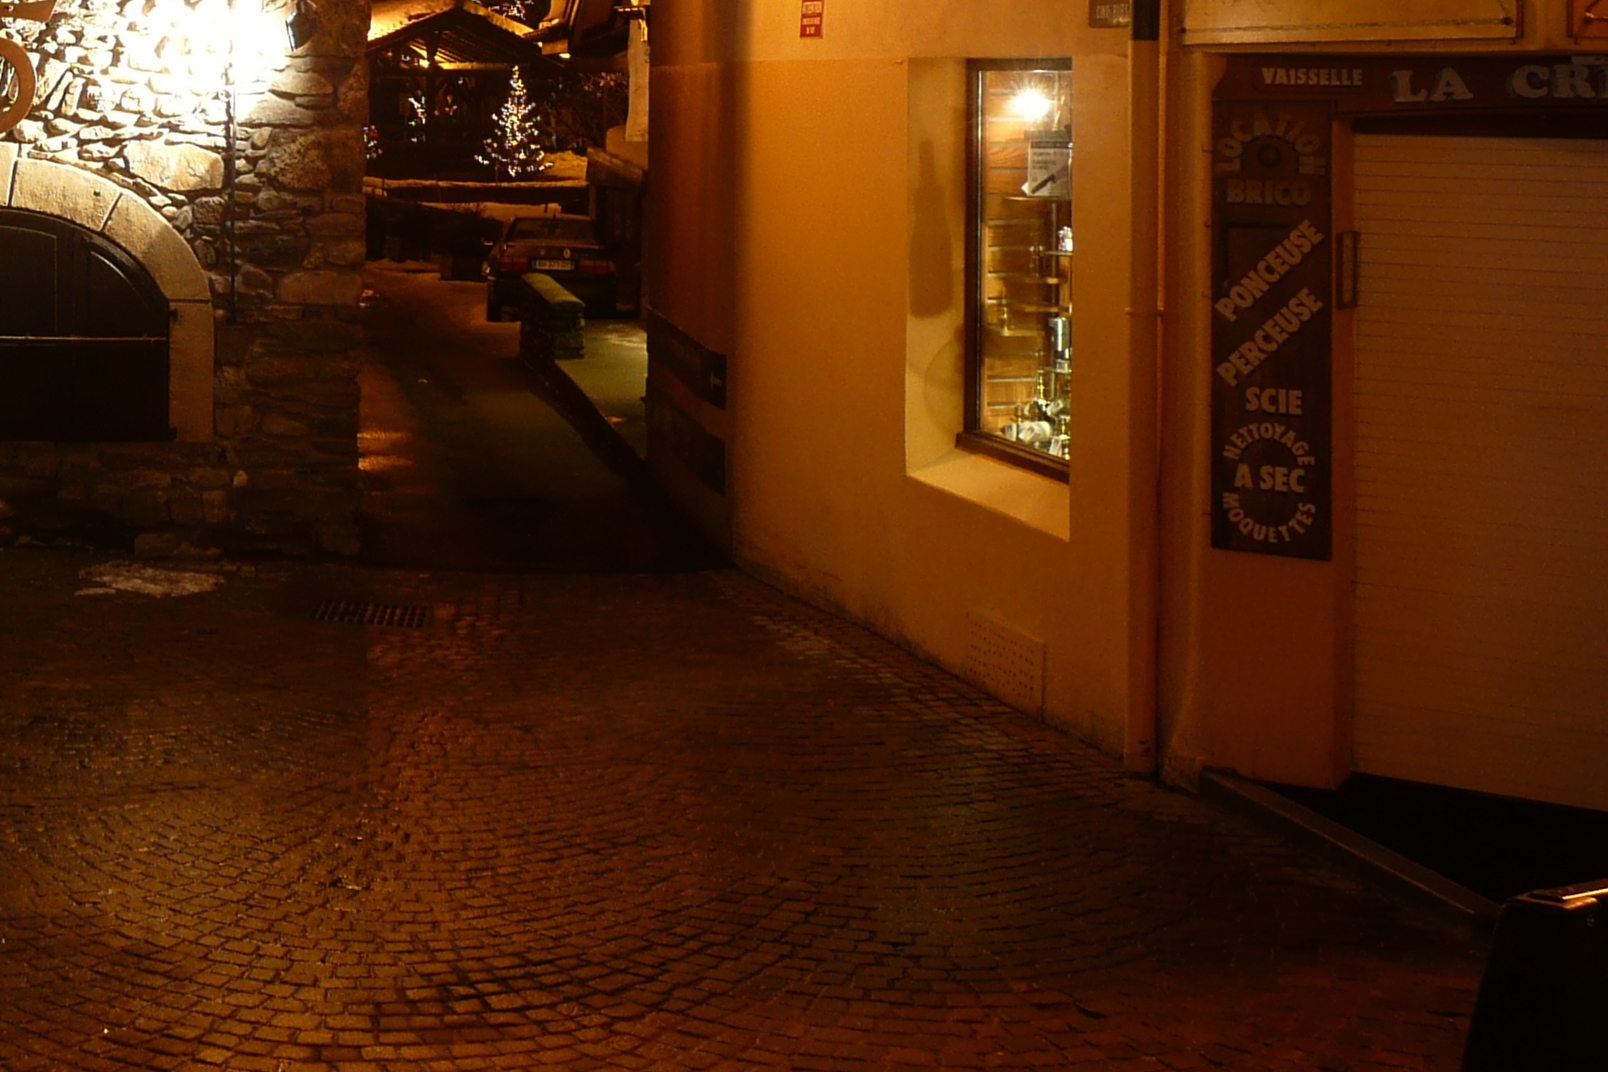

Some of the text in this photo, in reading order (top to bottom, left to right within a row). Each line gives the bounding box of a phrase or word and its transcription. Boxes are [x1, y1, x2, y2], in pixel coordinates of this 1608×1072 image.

[1262, 68, 1362, 86] VAISSELLE
[1392, 60, 1607, 102] LA CR
[1214, 113, 1327, 176] LOCATION
[1227, 179, 1311, 206] BRICO
[1216, 218, 1325, 323] PONCEUSE
[1216, 287, 1324, 387] PERCEUSE
[1245, 386, 1303, 416] SCIE
[1223, 422, 1315, 466] NETTOYAGE
[1234, 464, 1306, 493] A SEC
[1222, 491, 1316, 544] MOQUETTES
